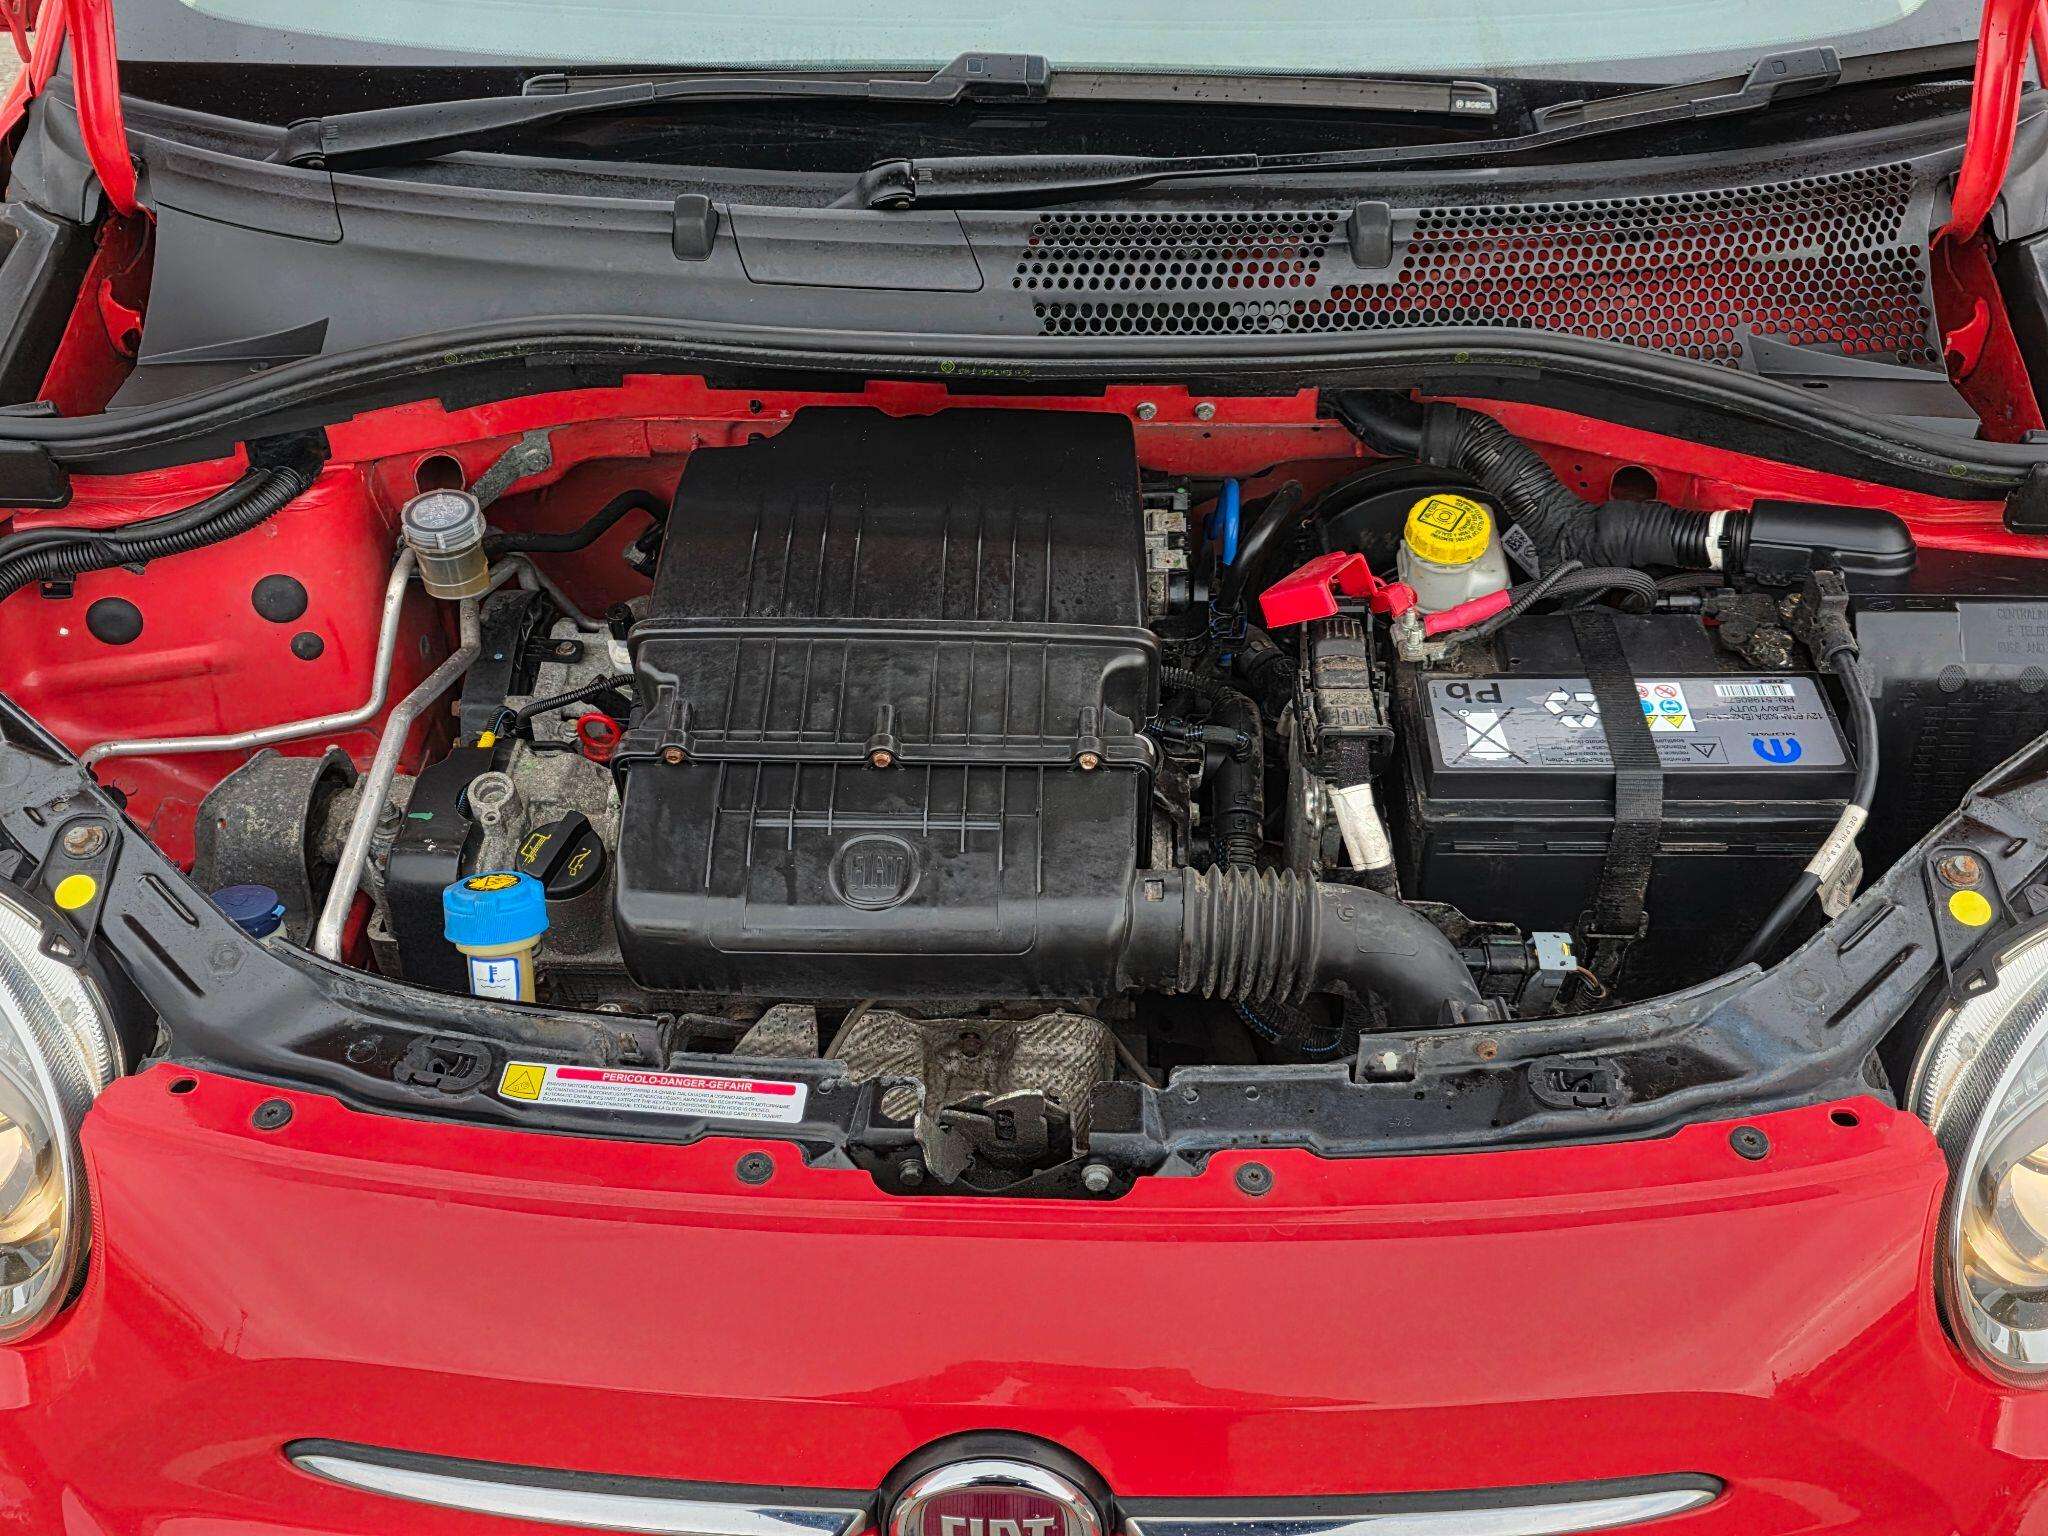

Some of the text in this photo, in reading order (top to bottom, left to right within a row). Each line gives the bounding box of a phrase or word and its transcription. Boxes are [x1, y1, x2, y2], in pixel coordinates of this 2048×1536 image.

[1446, 683, 1503, 704] Pb
[850, 855, 903, 889] FIAT
[602, 1072, 752, 1091] PERICOLO-DANGER-GEFAHR
